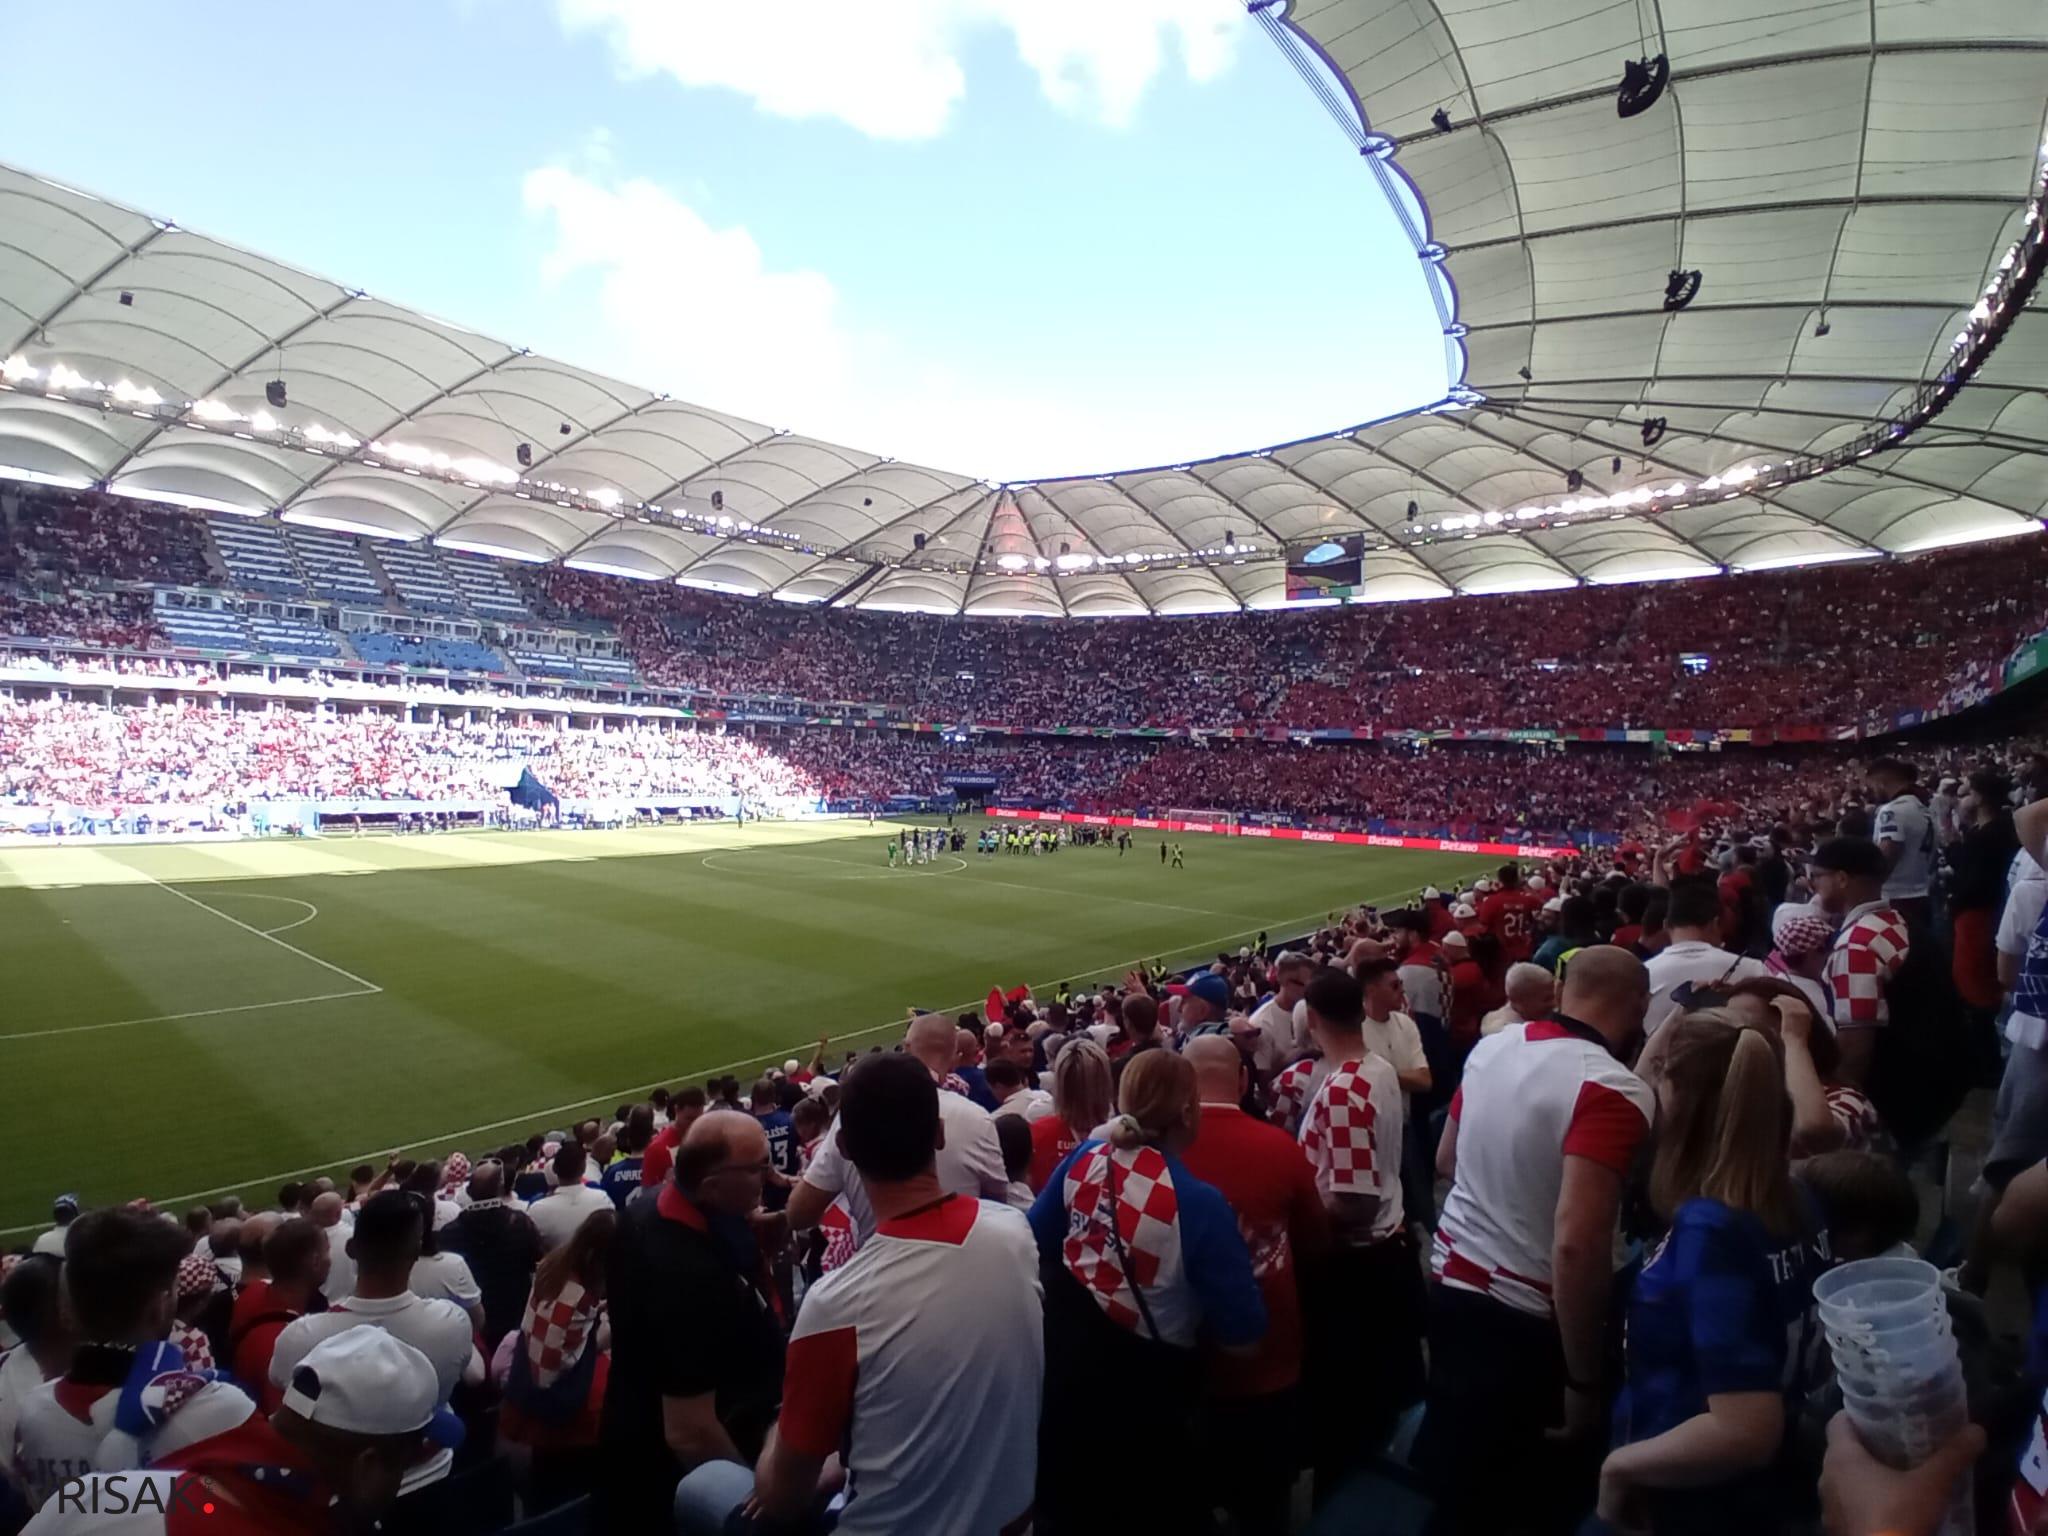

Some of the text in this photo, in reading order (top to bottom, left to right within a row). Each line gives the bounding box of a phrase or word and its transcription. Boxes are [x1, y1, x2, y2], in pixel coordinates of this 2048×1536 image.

[1302, 830, 1334, 842] Betano
[1367, 834, 1403, 846] Betano
[1440, 840, 1478, 853] Betano
[1503, 912, 1523, 937] 21
